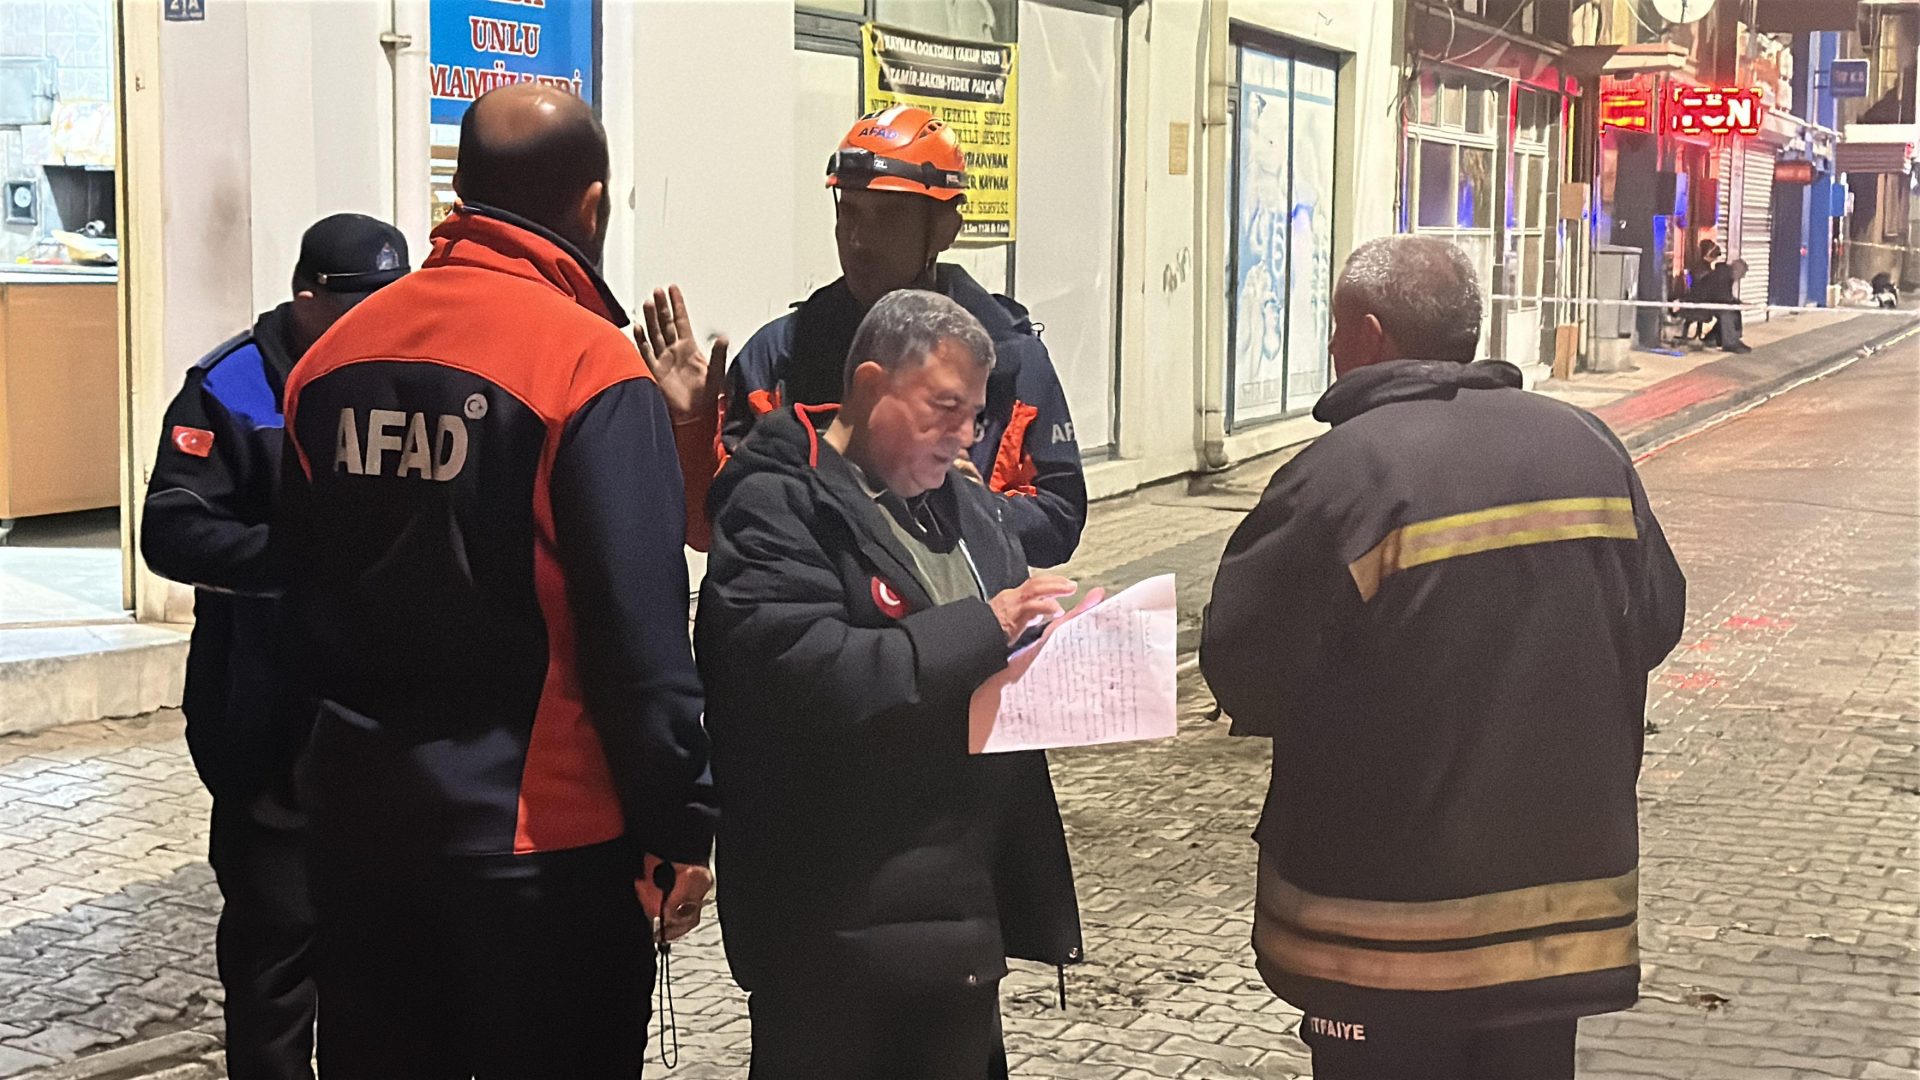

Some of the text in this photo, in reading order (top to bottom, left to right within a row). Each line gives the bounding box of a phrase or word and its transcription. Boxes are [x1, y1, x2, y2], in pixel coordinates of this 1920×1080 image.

[470, 18, 540, 56] UNLU
[884, 35, 916, 56] KAYNAK
[858, 126, 898, 139] AFAD
[333, 407, 469, 482] AFAD
